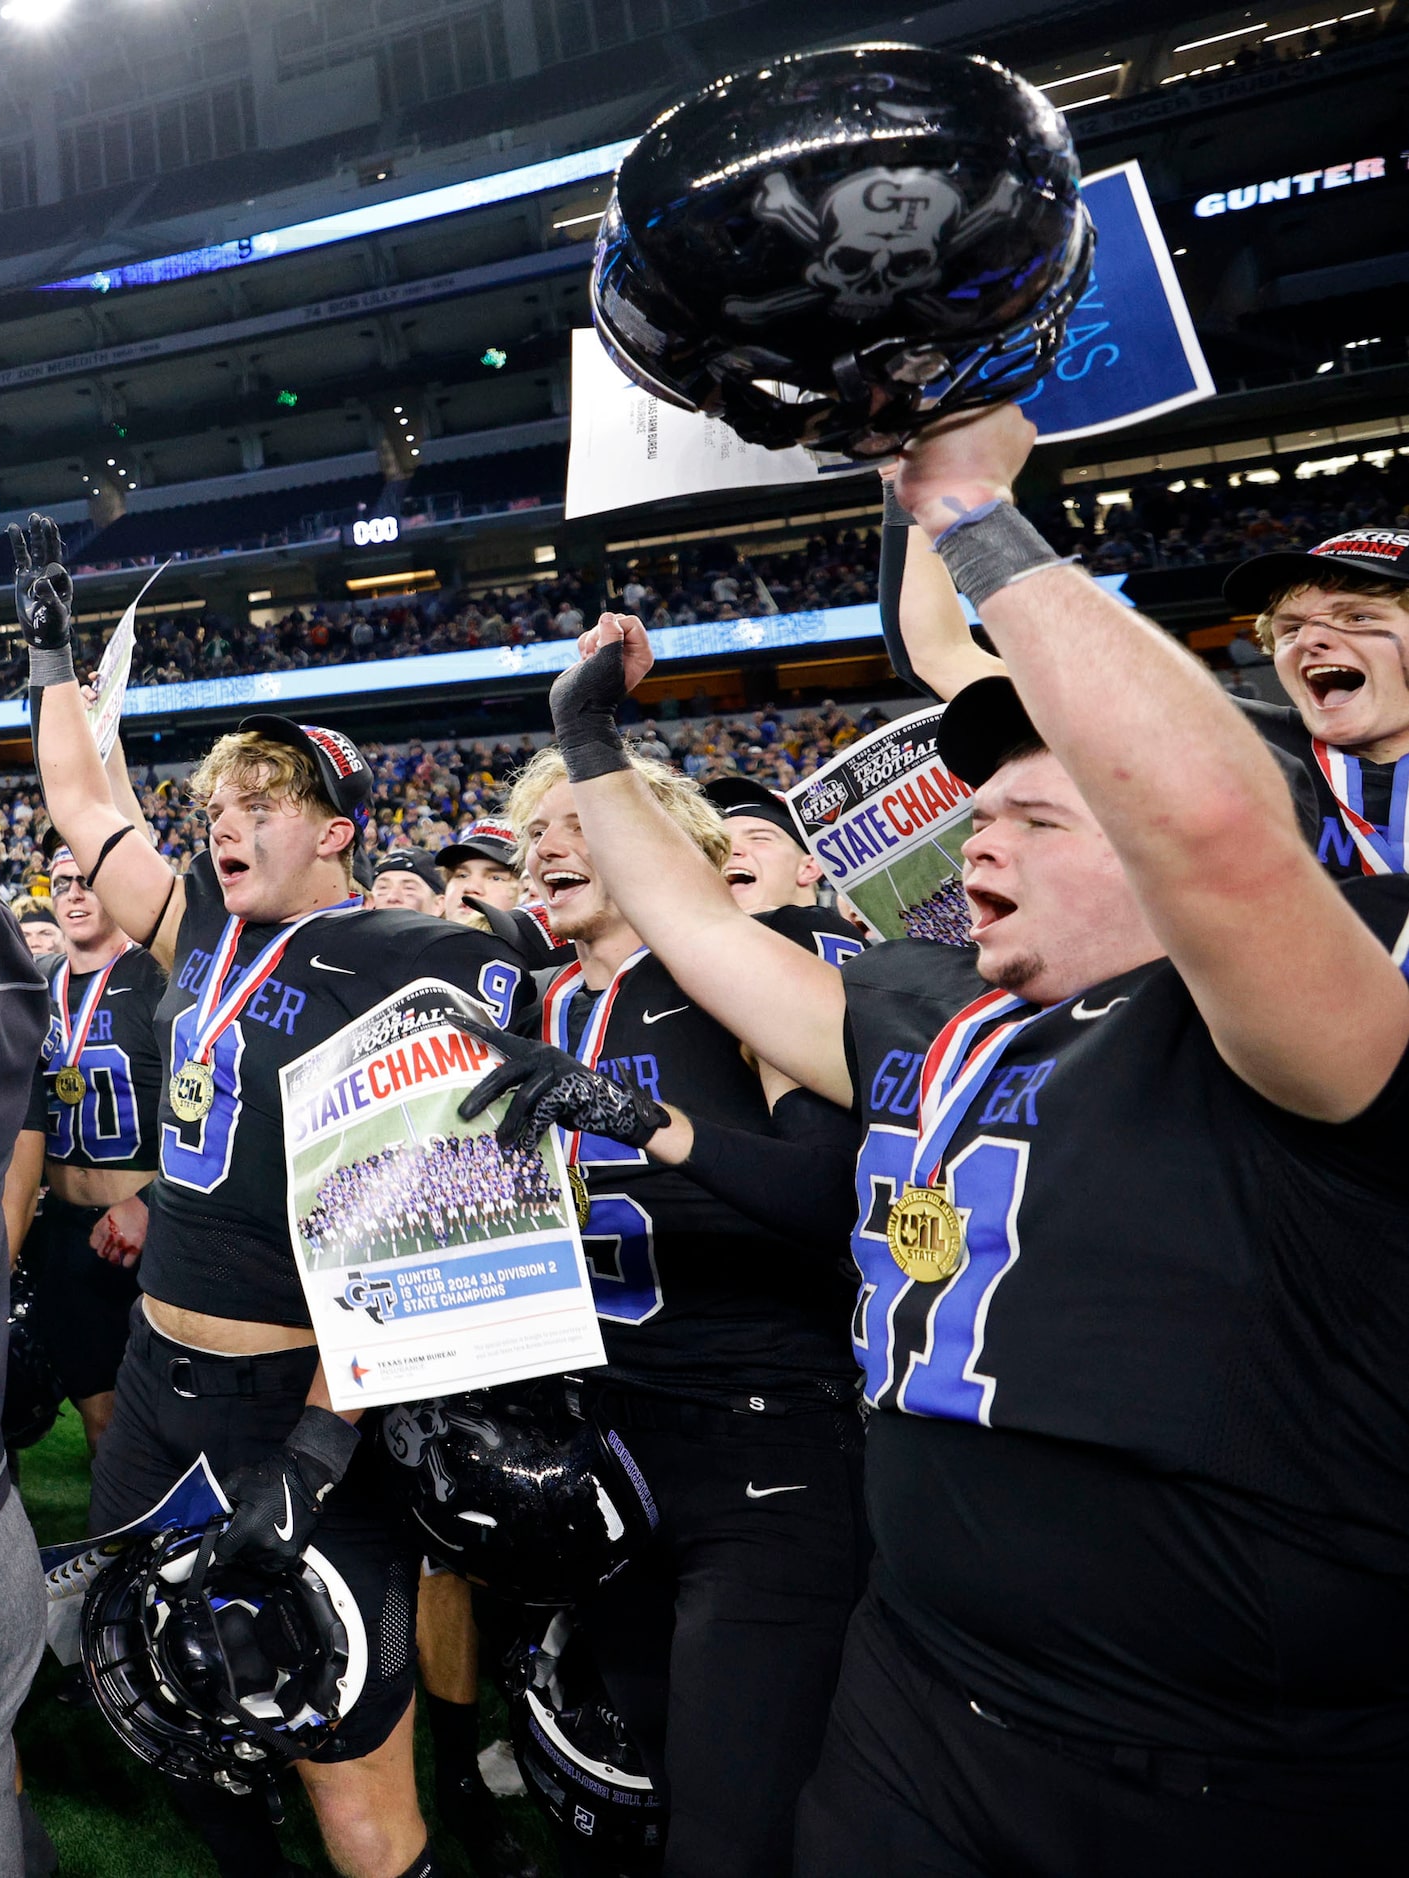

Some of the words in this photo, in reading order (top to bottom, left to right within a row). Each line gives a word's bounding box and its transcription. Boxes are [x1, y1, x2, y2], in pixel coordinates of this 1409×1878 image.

[1194, 157, 1386, 218] GUNTER
[862, 180, 930, 231] GT
[647, 415, 658, 433] FARM
[647, 433, 658, 460] BUREAU
[882, 731, 901, 744] STATE
[854, 744, 901, 782] TEXAS
[860, 738, 939, 794] FOOTBAL
[803, 787, 847, 822] STATE
[477, 960, 523, 1031] 9
[161, 1003, 248, 1194] 9
[178, 1077, 203, 1103] UIL
[897, 1190, 959, 1230] INTERSCHOLASTIC
[901, 1211, 946, 1252] UIL
[907, 1248, 938, 1262] STATE
[397, 1267, 441, 1286] GUNTER
[400, 1287, 412, 1299] IS
[414, 1281, 445, 1297] YOUR
[448, 1275, 478, 1291] 2024
[480, 1271, 496, 1285] 3A
[498, 1263, 546, 1283] DIVISION
[548, 1260, 558, 1274] 2
[403, 1298, 440, 1313] STATE
[441, 1283, 507, 1307] CHAMPIONS
[377, 1357, 403, 1369] TEXAS
[404, 1354, 426, 1366] FARM
[427, 1350, 457, 1362] BUREAU
[749, 1396, 766, 1411] S
[573, 1804, 595, 1836] 2
